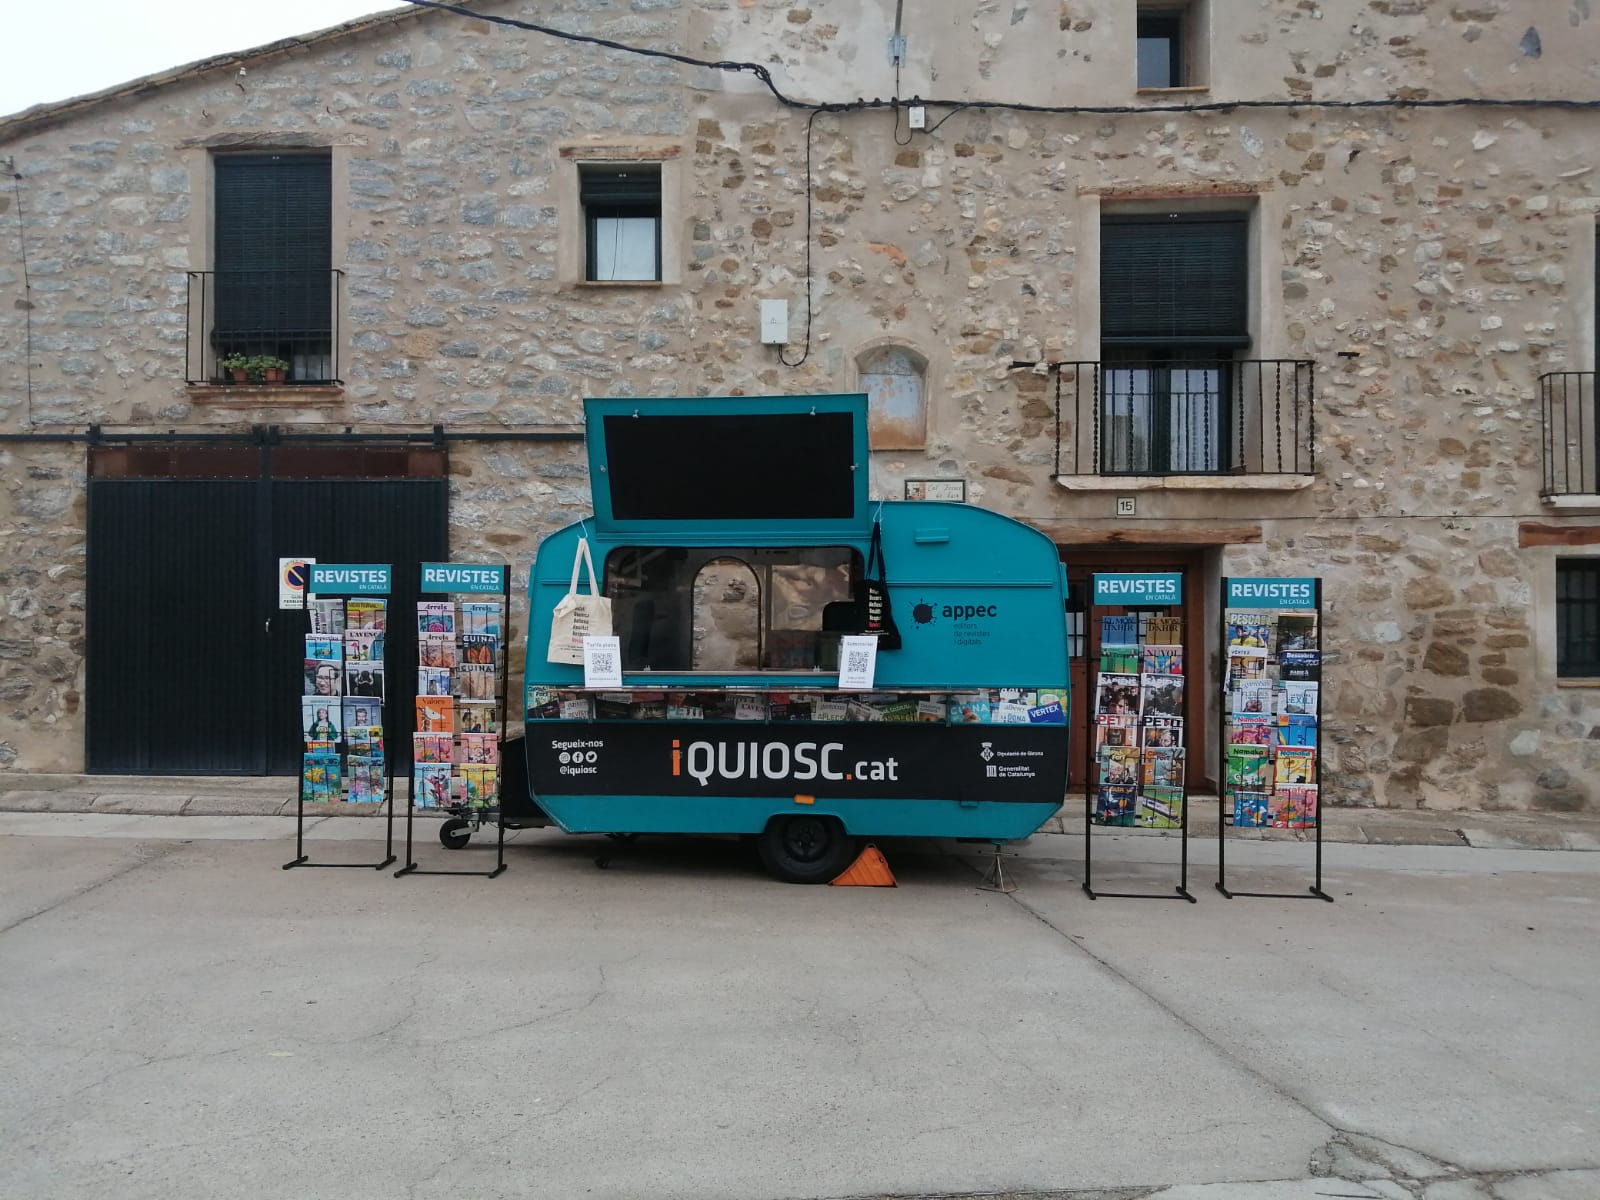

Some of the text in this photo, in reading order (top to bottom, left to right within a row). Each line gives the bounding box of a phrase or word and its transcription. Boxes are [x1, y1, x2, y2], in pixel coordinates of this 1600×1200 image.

[1120, 501, 1133, 511] 15
[314, 570, 387, 583] REVISTES
[424, 568, 500, 584] REVISTES
[1098, 579, 1176, 593] REVISTES
[1231, 583, 1310, 597] REVISTES
[942, 604, 998, 621] appec
[551, 739, 604, 751] Segueix-nos
[559, 765, 598, 777] @iquiosc
